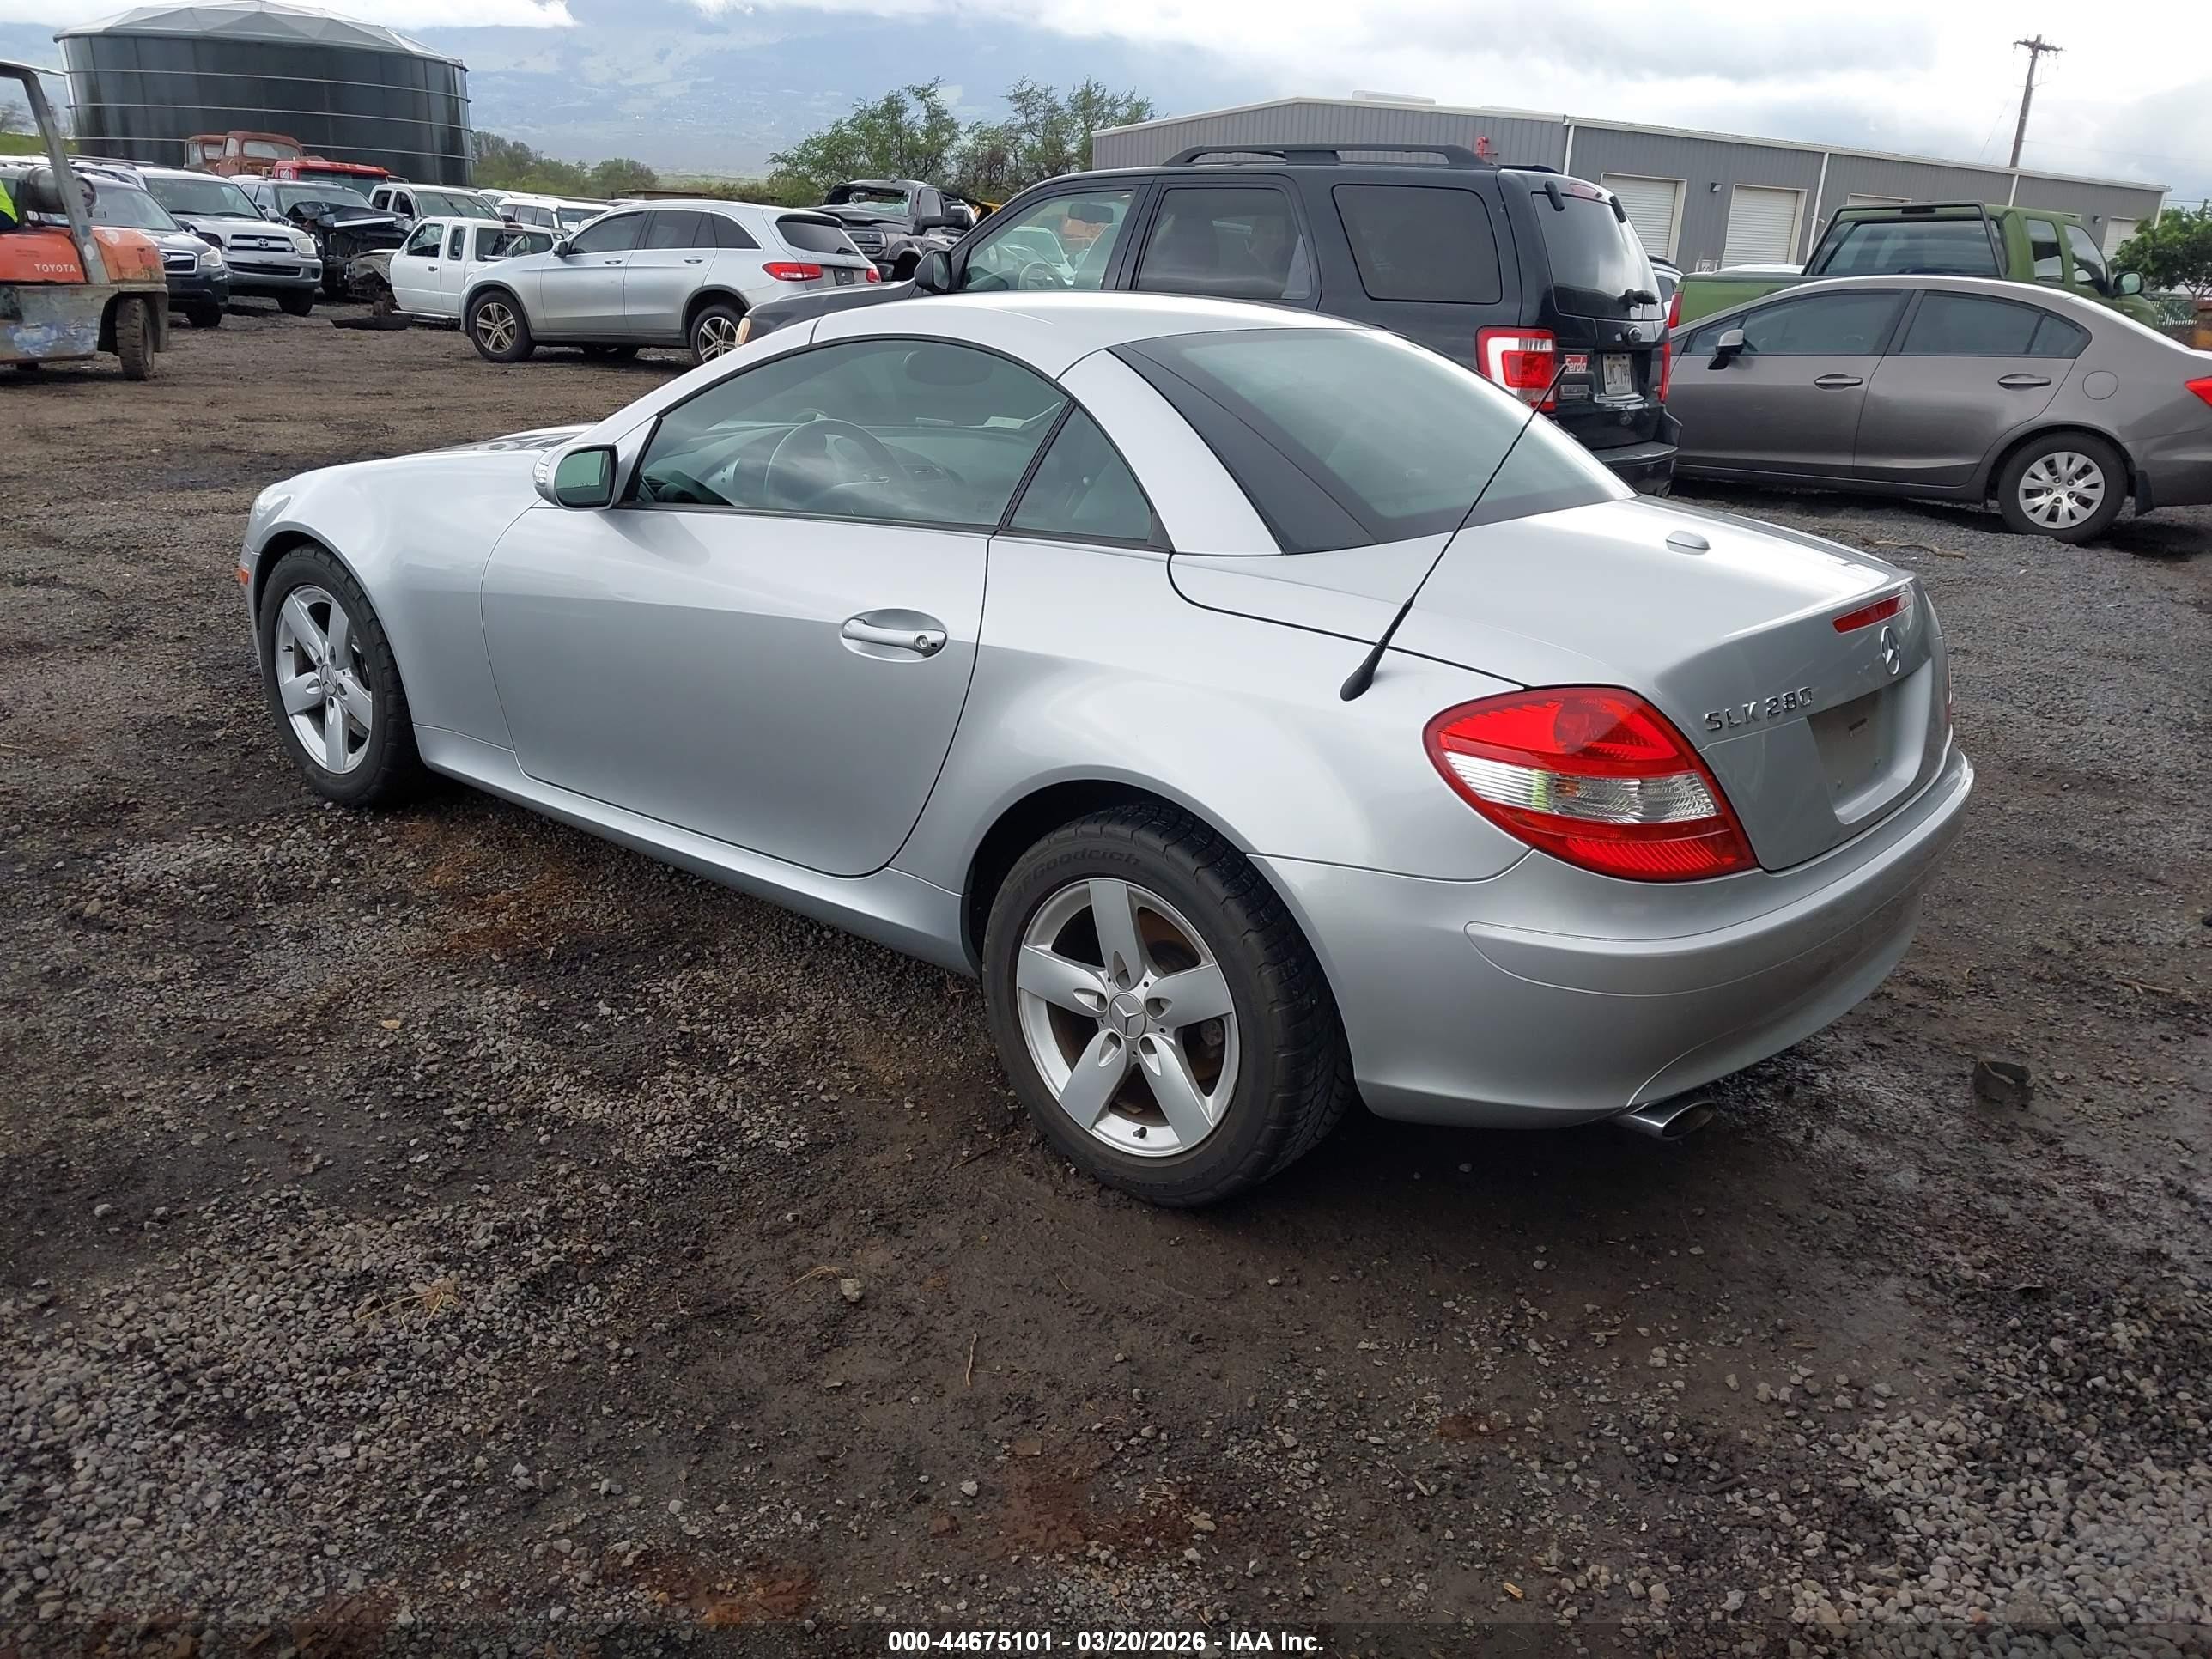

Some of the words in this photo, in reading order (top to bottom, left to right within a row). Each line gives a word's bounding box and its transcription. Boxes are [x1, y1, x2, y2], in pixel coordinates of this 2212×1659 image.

[33, 264, 76, 273] TOYOTA
[1704, 701, 1760, 732] SLK
[1765, 686, 1814, 719] 280
